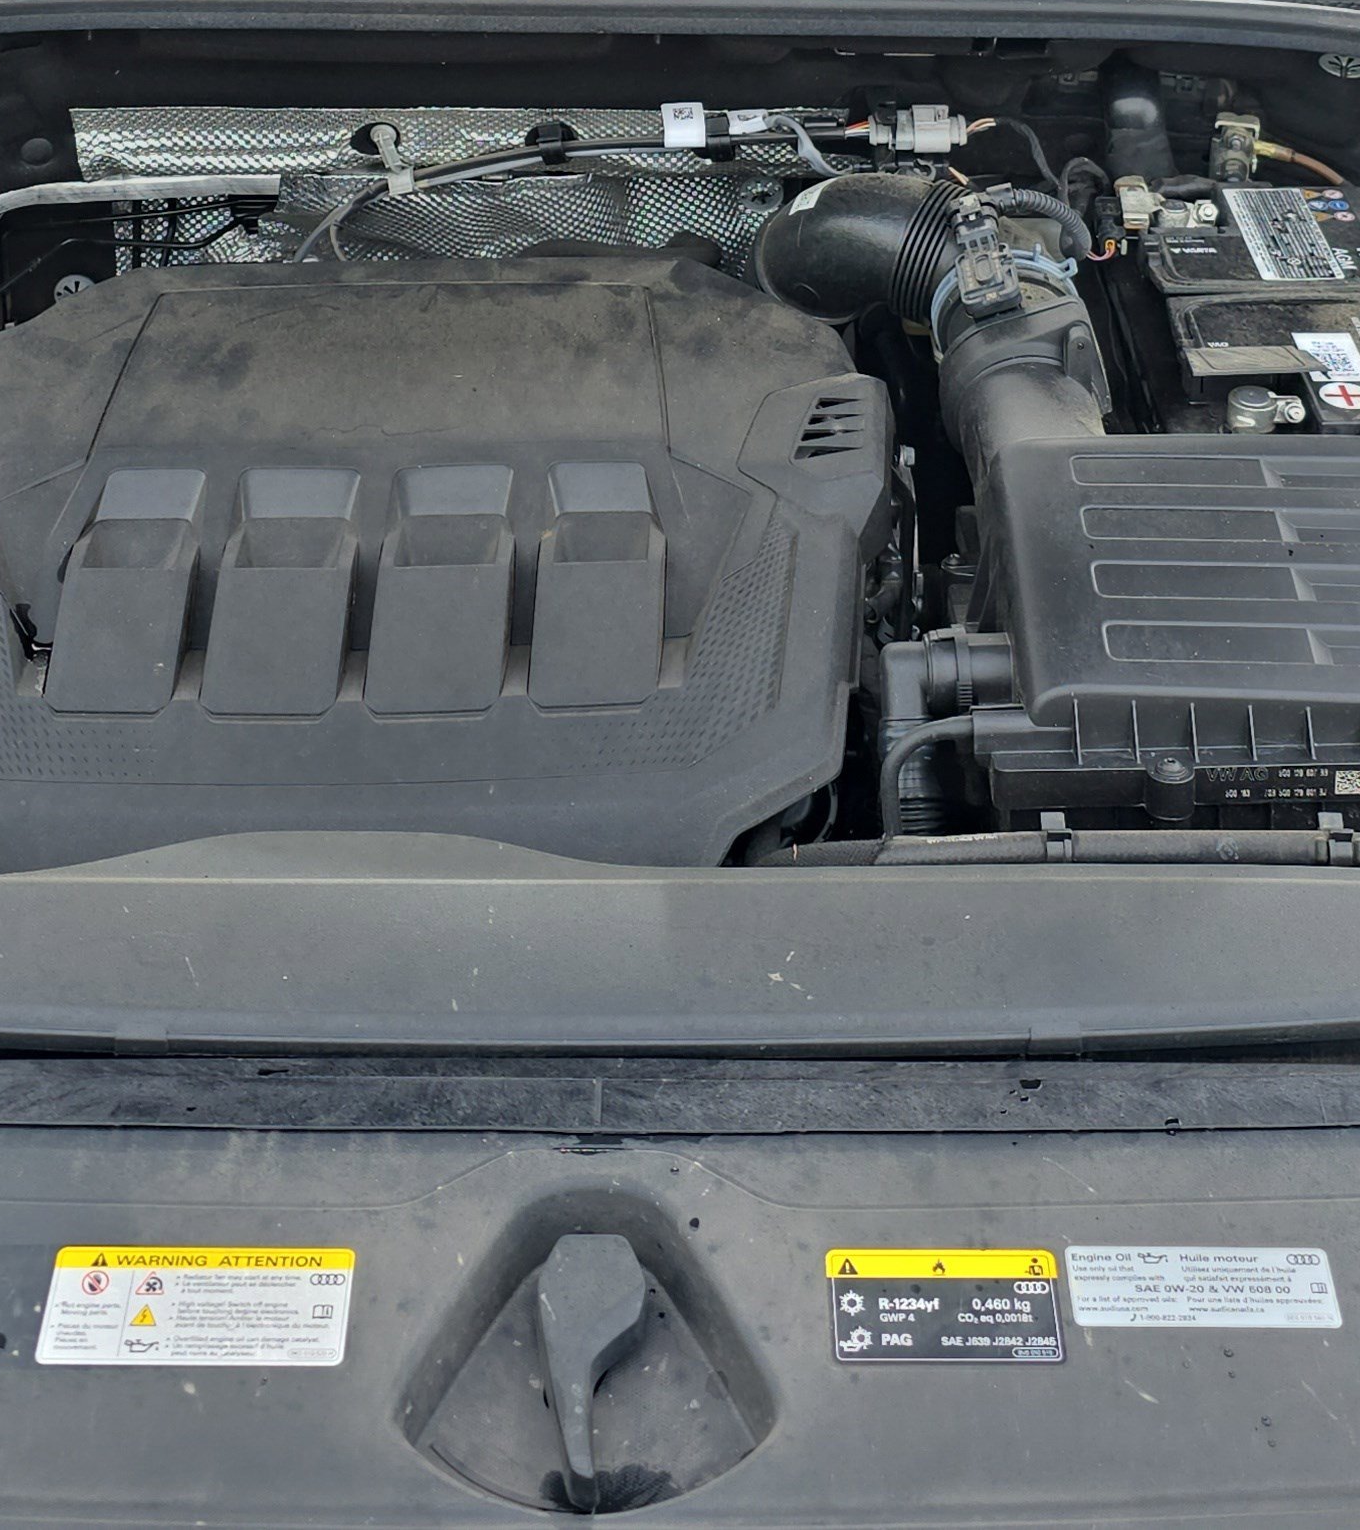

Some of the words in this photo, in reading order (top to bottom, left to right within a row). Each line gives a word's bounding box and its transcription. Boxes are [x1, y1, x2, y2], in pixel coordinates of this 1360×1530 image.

[1331, 247, 1357, 270] AGM
[1206, 766, 1237, 782] VW
[1240, 766, 1269, 781] AG
[116, 1254, 208, 1266] WARNING
[218, 1255, 323, 1267] ATTENTION
[1071, 1253, 1112, 1262] Engine
[1115, 1253, 1132, 1261] Oil
[1179, 1254, 1210, 1262] Huile
[1213, 1254, 1259, 1263] moteur
[1211, 1266, 1258, 1274] uniquement
[1164, 1285, 1205, 1293] 0W-20
[1208, 1285, 1219, 1293] &
[1221, 1285, 1245, 1293] VW
[1275, 1286, 1291, 1294] 00
[878, 1297, 940, 1313] R-1234yf
[972, 1298, 1011, 1311] 0,460
[1014, 1298, 1031, 1313] kg
[1123, 1296, 1159, 1304] approved
[880, 1313, 907, 1322] GWP
[908, 1313, 916, 1322] 4
[980, 1315, 994, 1324] eq
[881, 1333, 914, 1346] PAG
[941, 1336, 965, 1346] SAE
[965, 1336, 991, 1346] J639
